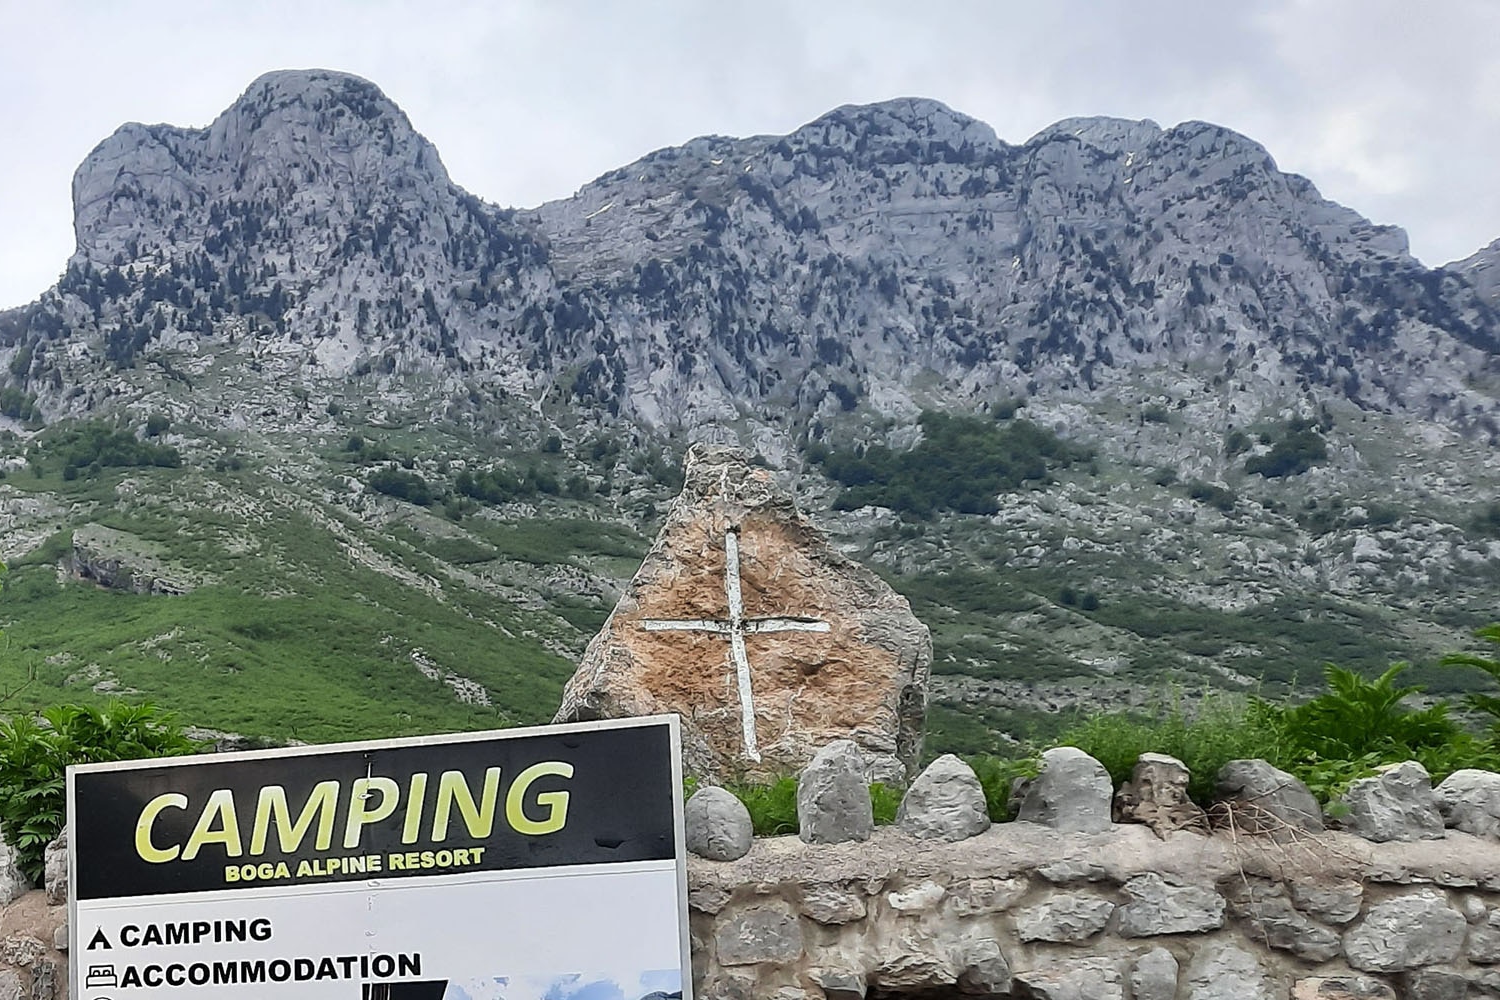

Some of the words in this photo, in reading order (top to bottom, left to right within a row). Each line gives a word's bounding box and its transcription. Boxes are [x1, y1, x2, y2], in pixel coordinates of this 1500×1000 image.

[135, 761, 574, 863] CAMPING
[225, 861, 290, 882] BOGA
[296, 854, 381, 876] ALPINE
[389, 847, 485, 870] RESORT
[120, 919, 272, 947] CAMPING
[120, 953, 421, 988] ACCOMMODATION
